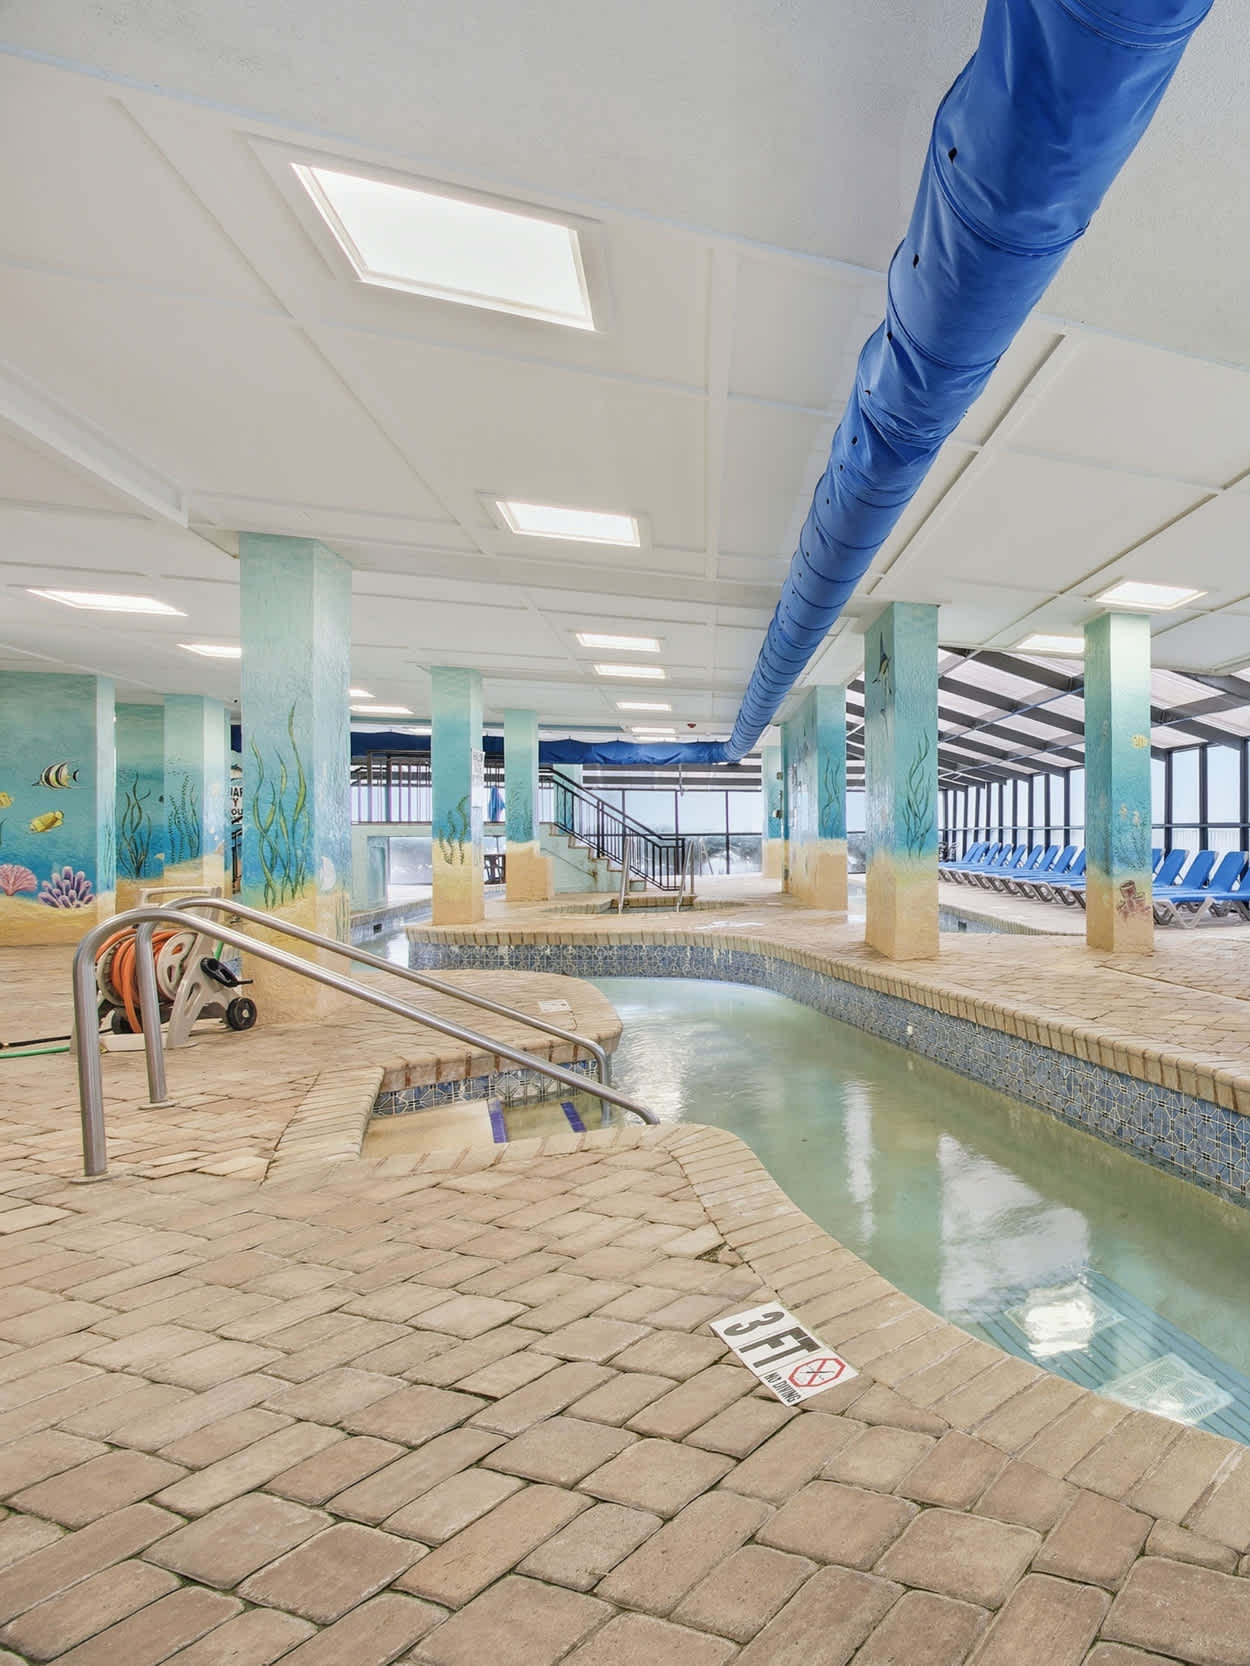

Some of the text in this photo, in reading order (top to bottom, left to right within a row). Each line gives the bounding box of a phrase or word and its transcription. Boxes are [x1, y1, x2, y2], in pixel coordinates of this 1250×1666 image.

[724, 1312, 821, 1368] 3 FT
[764, 1372, 801, 1403] NO DIVING
